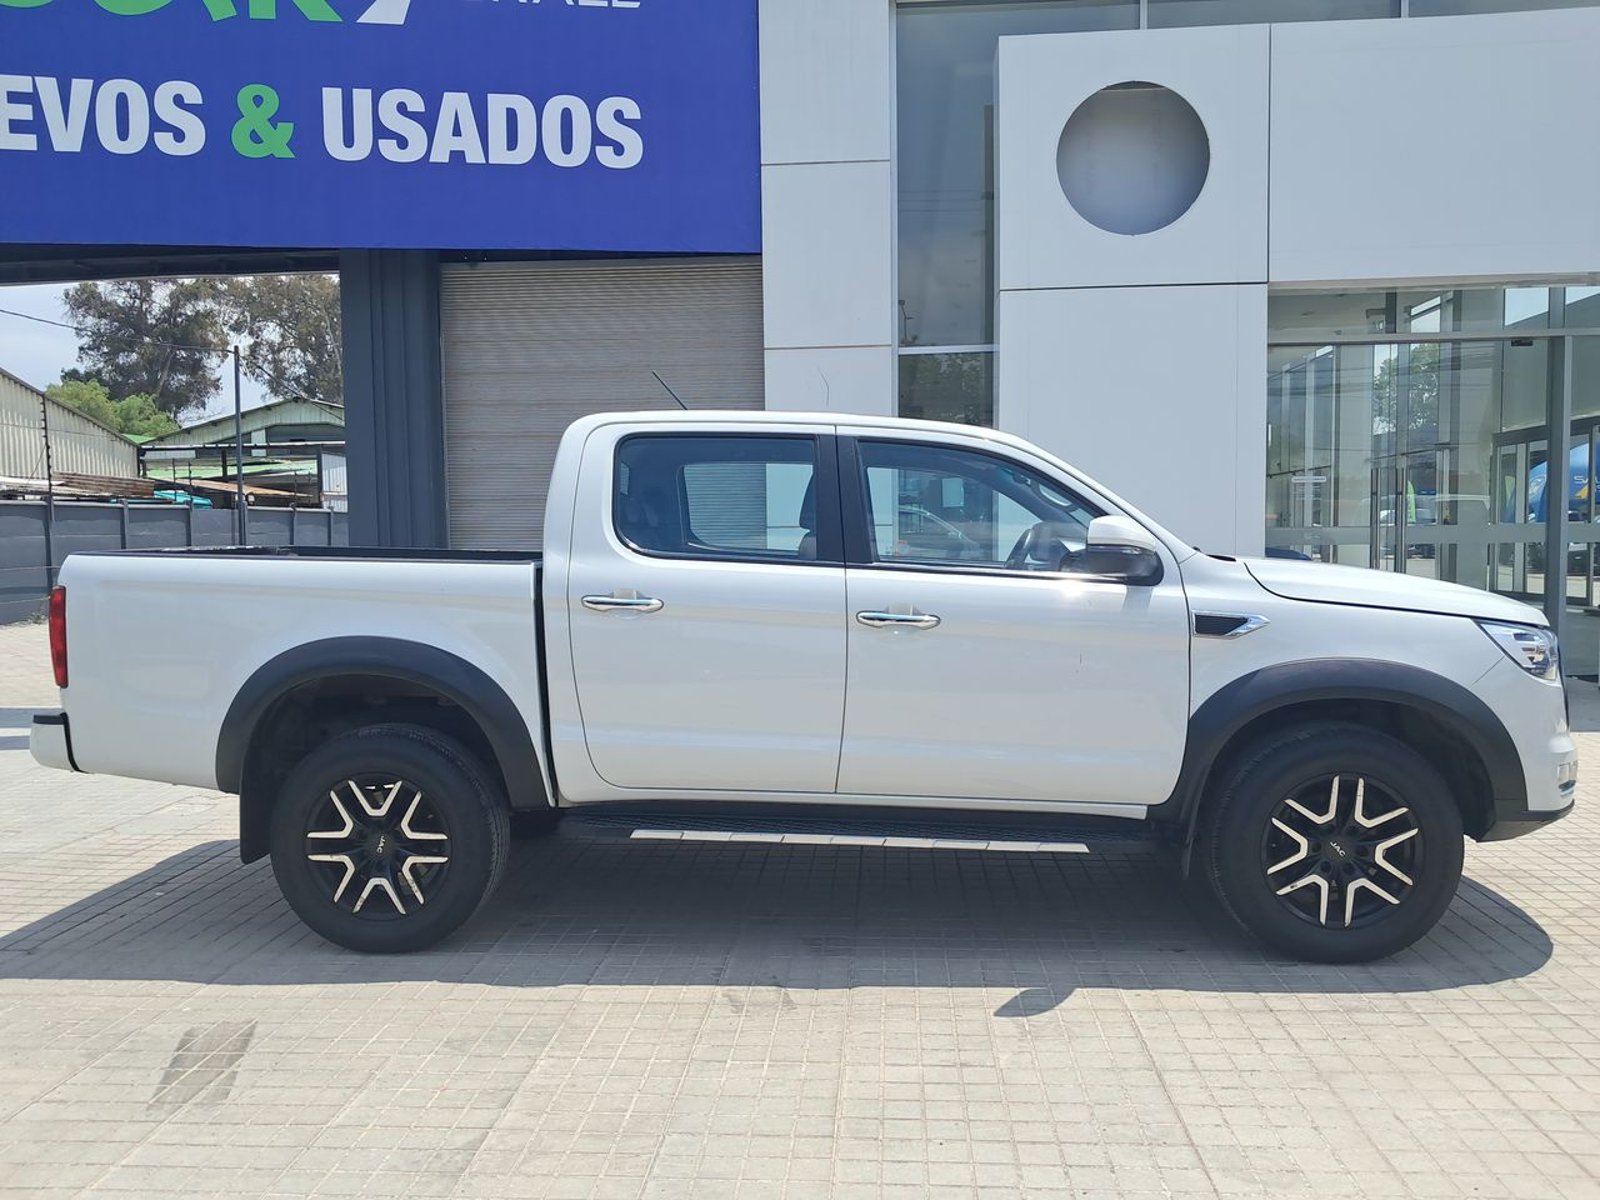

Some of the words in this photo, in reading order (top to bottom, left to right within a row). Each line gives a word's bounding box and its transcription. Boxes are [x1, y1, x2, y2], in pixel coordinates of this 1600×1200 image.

[0, 74, 206, 156] EVOS
[231, 84, 295, 158] &
[322, 87, 643, 169] USADOS
[1330, 841, 1346, 857] JAC
